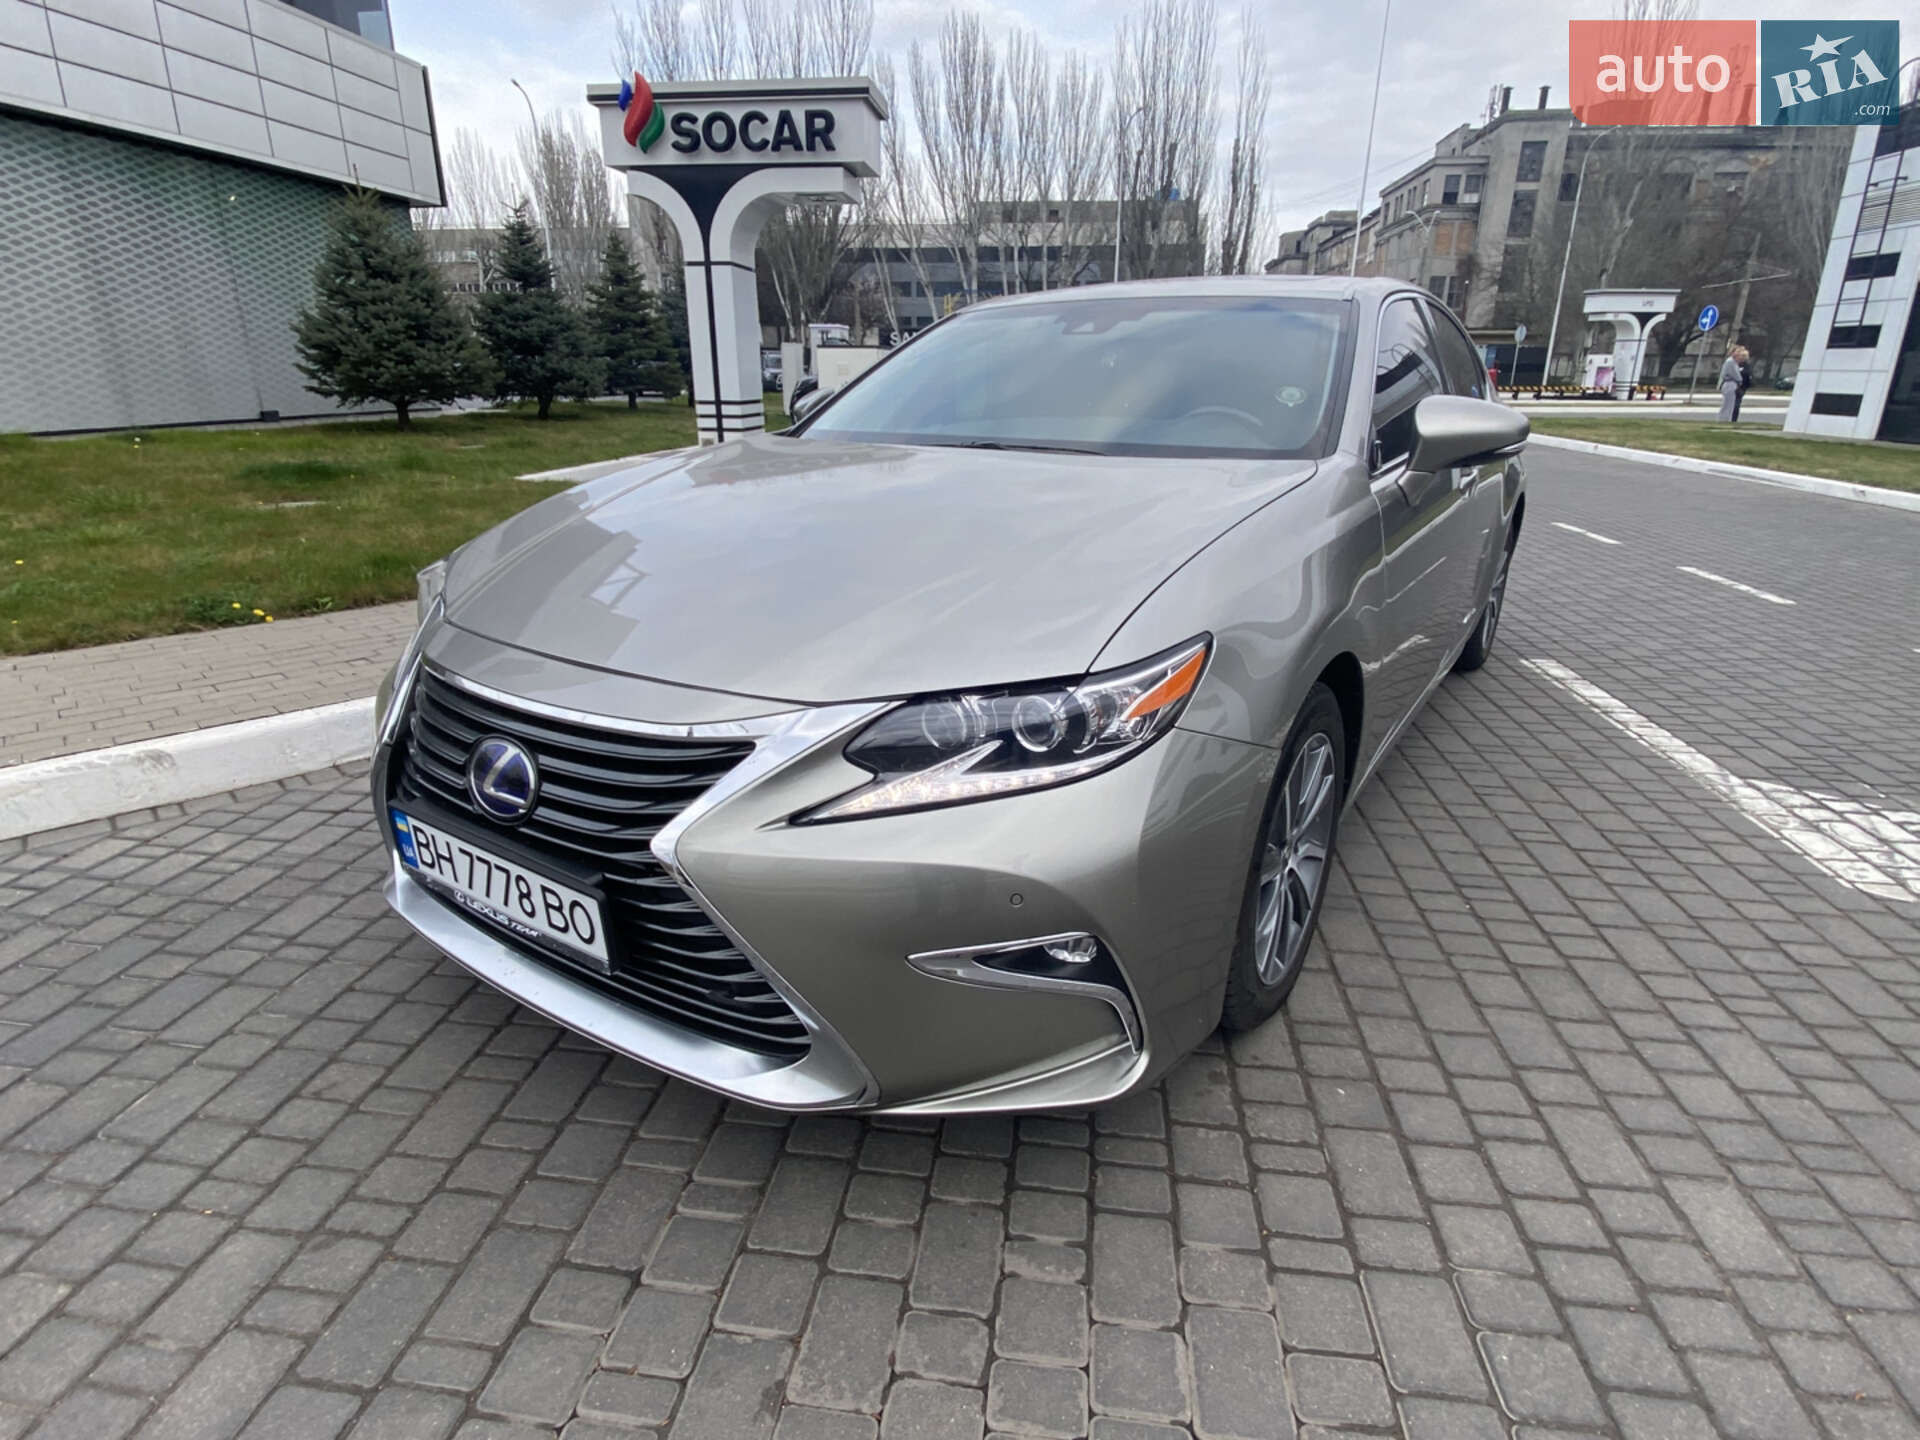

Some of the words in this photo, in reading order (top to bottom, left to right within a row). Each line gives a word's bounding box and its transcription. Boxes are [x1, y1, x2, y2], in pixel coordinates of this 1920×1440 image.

[670, 110, 836, 153] SOCAR
[412, 824, 459, 883] BH
[458, 847, 536, 919] 7778
[540, 884, 596, 944] BO
